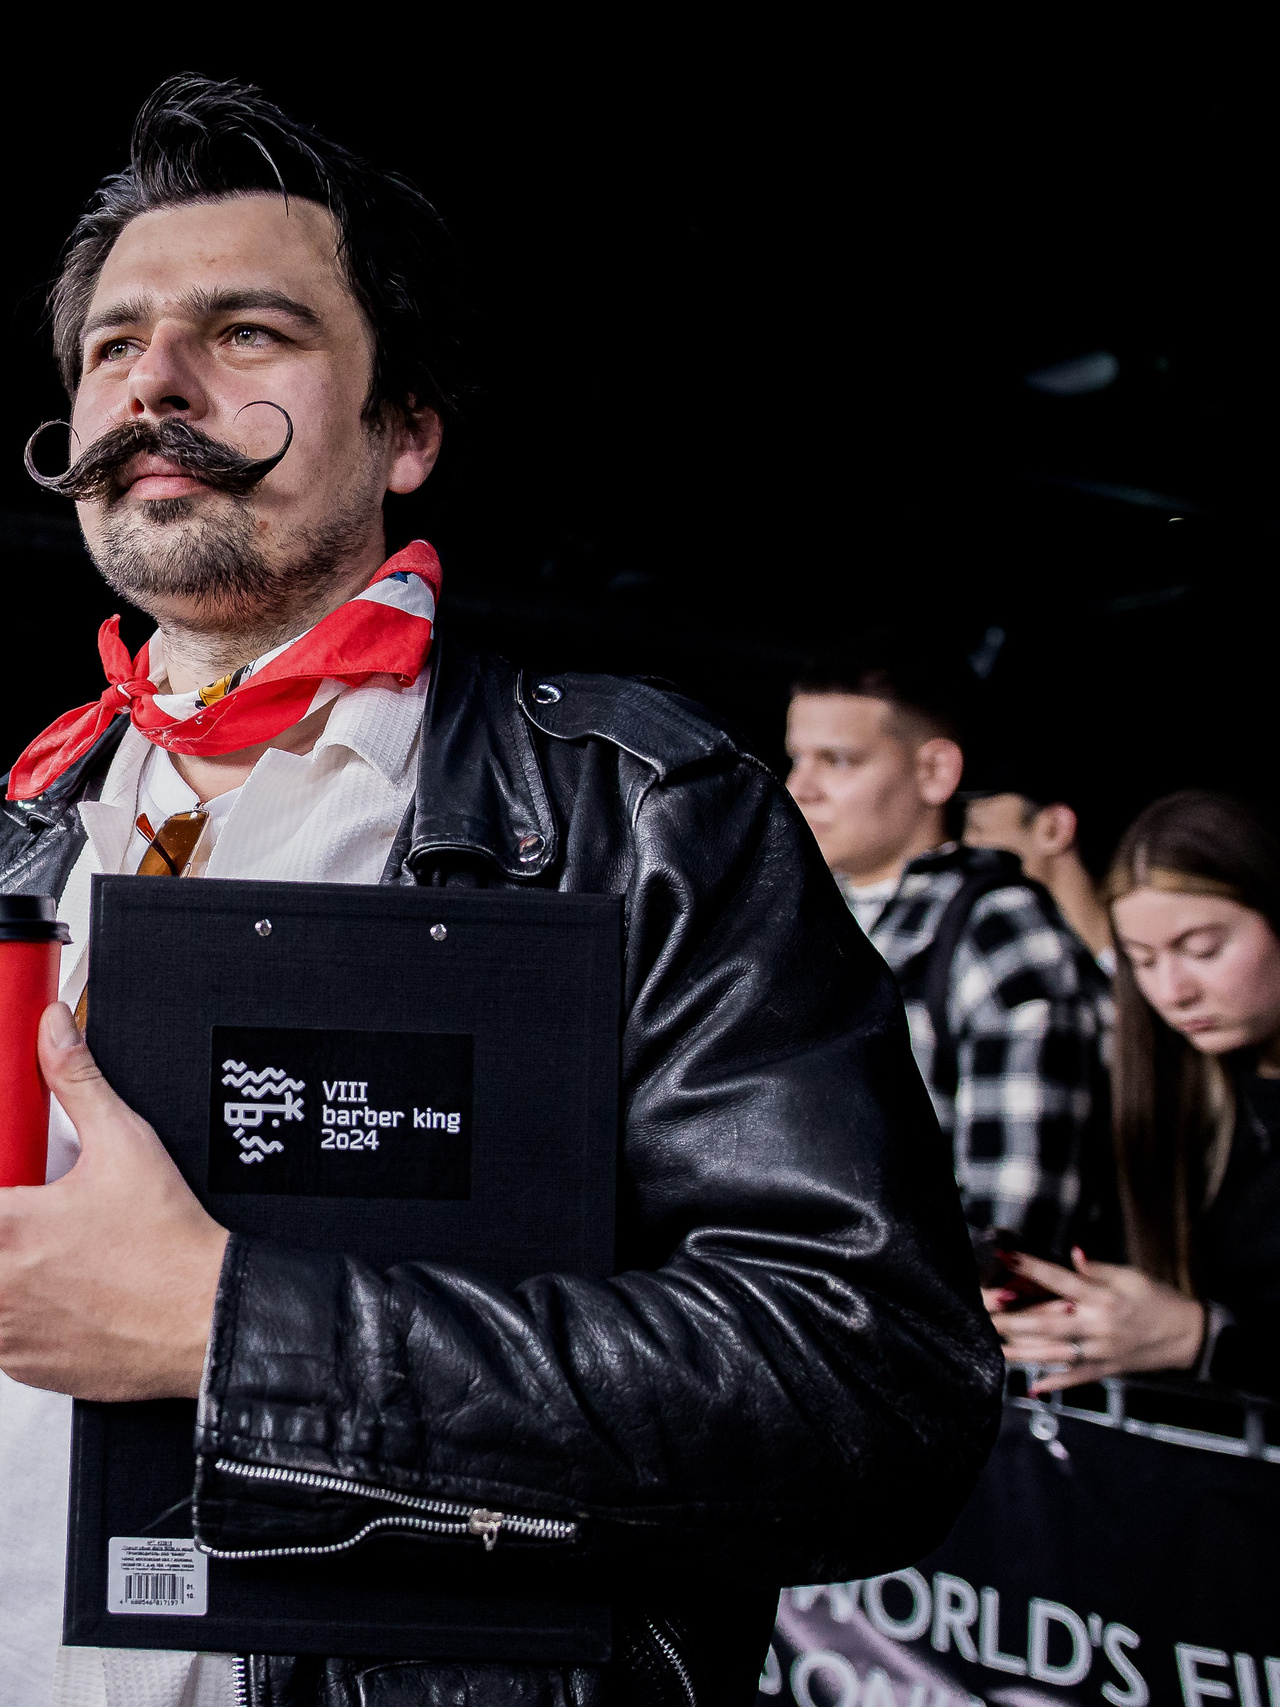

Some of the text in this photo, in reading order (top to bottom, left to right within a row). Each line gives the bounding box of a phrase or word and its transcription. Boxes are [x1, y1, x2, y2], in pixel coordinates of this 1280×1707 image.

[322, 1081, 368, 1102] VIII
[322, 1104, 461, 1133] barber king
